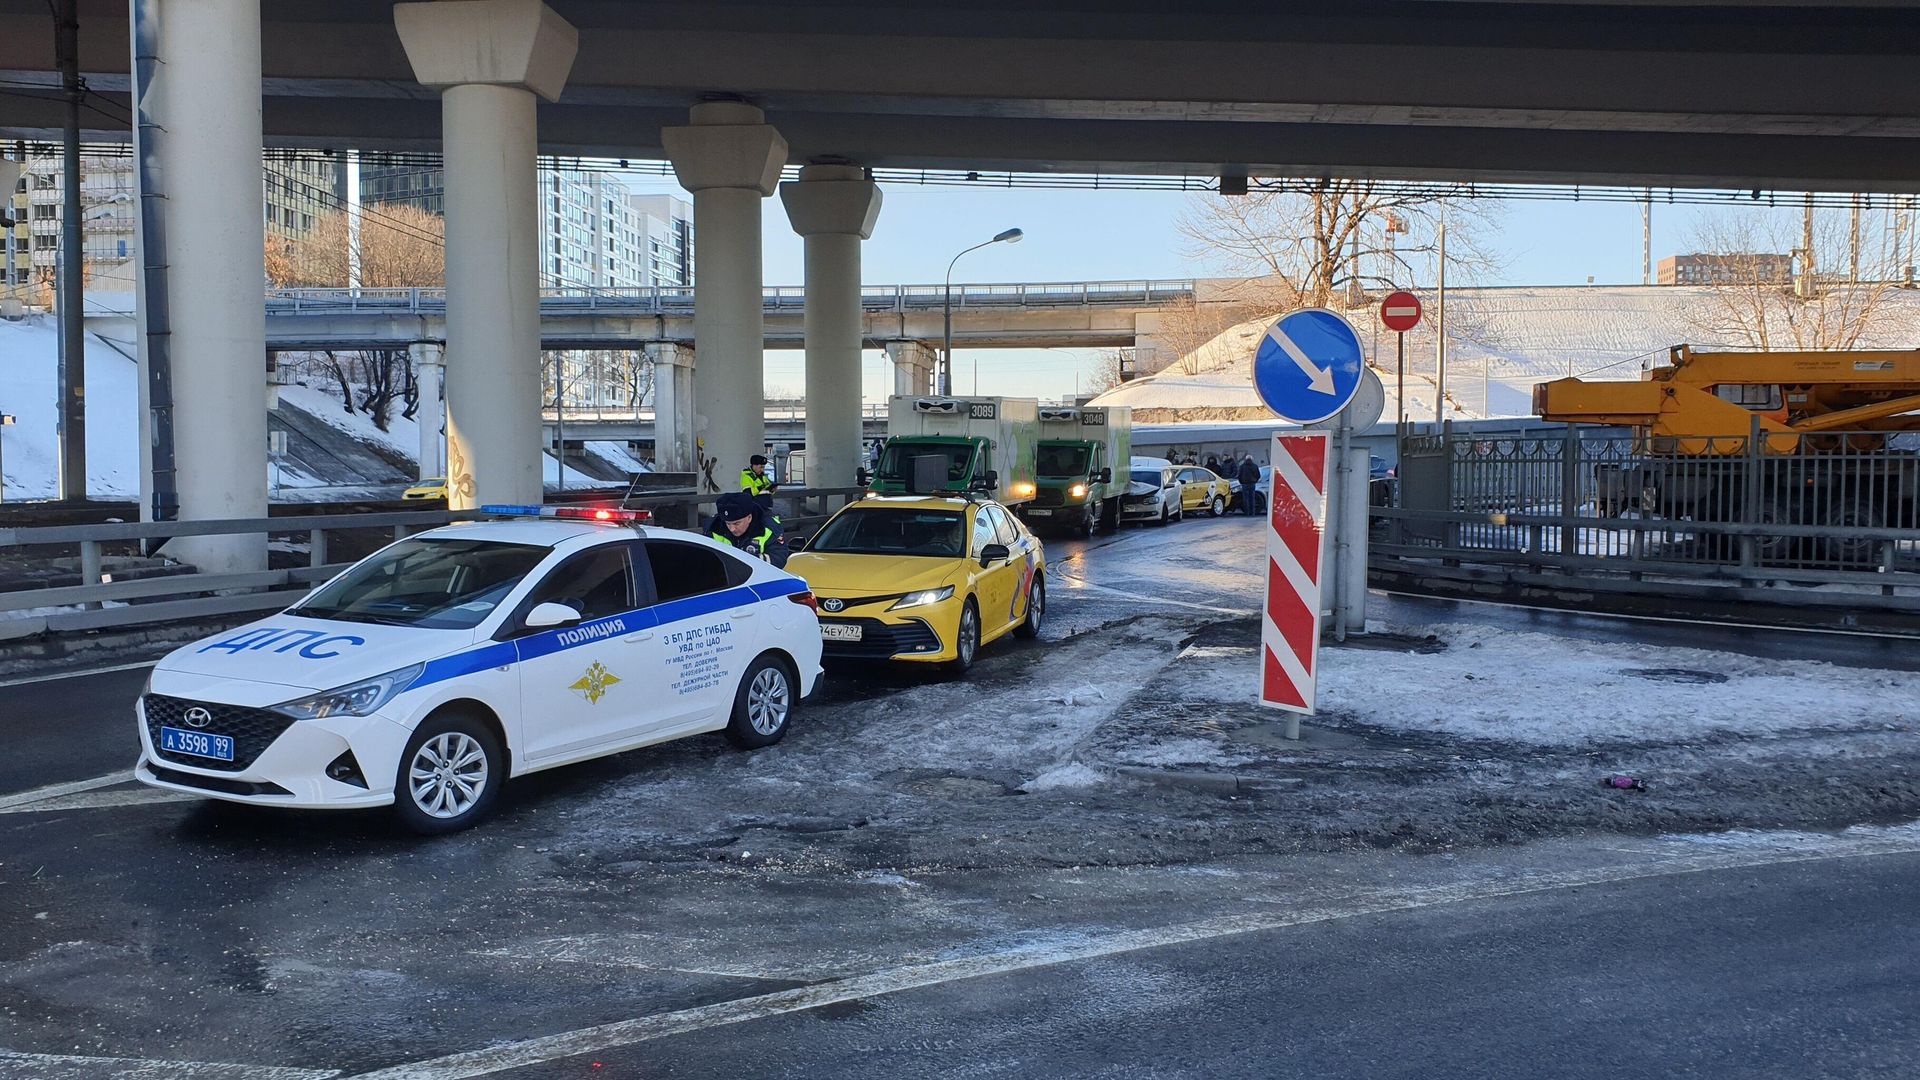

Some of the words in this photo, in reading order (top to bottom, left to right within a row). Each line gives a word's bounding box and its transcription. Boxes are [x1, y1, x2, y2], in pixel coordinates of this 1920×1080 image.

[971, 405, 993, 418] 3089
[1084, 415, 1103, 424] 3048
[557, 619, 626, 646] ПОЛИЦИЯ
[664, 636, 670, 645] 3
[672, 632, 683, 643] БП
[686, 628, 703, 642] ДПС
[705, 622, 732, 636] ГИБДД
[844, 626, 859, 634] 797
[196, 627, 366, 659] ДПС
[678, 643, 693, 653] УВД
[706, 636, 720, 647] ЦАО
[694, 657, 718, 667] ДОВЕРИЯ
[683, 674, 711, 687] ДЕЖУРНОЙ
[712, 670, 728, 678] ЧАСТИ
[178, 732, 208, 754] 3598
[215, 738, 228, 752] 99
